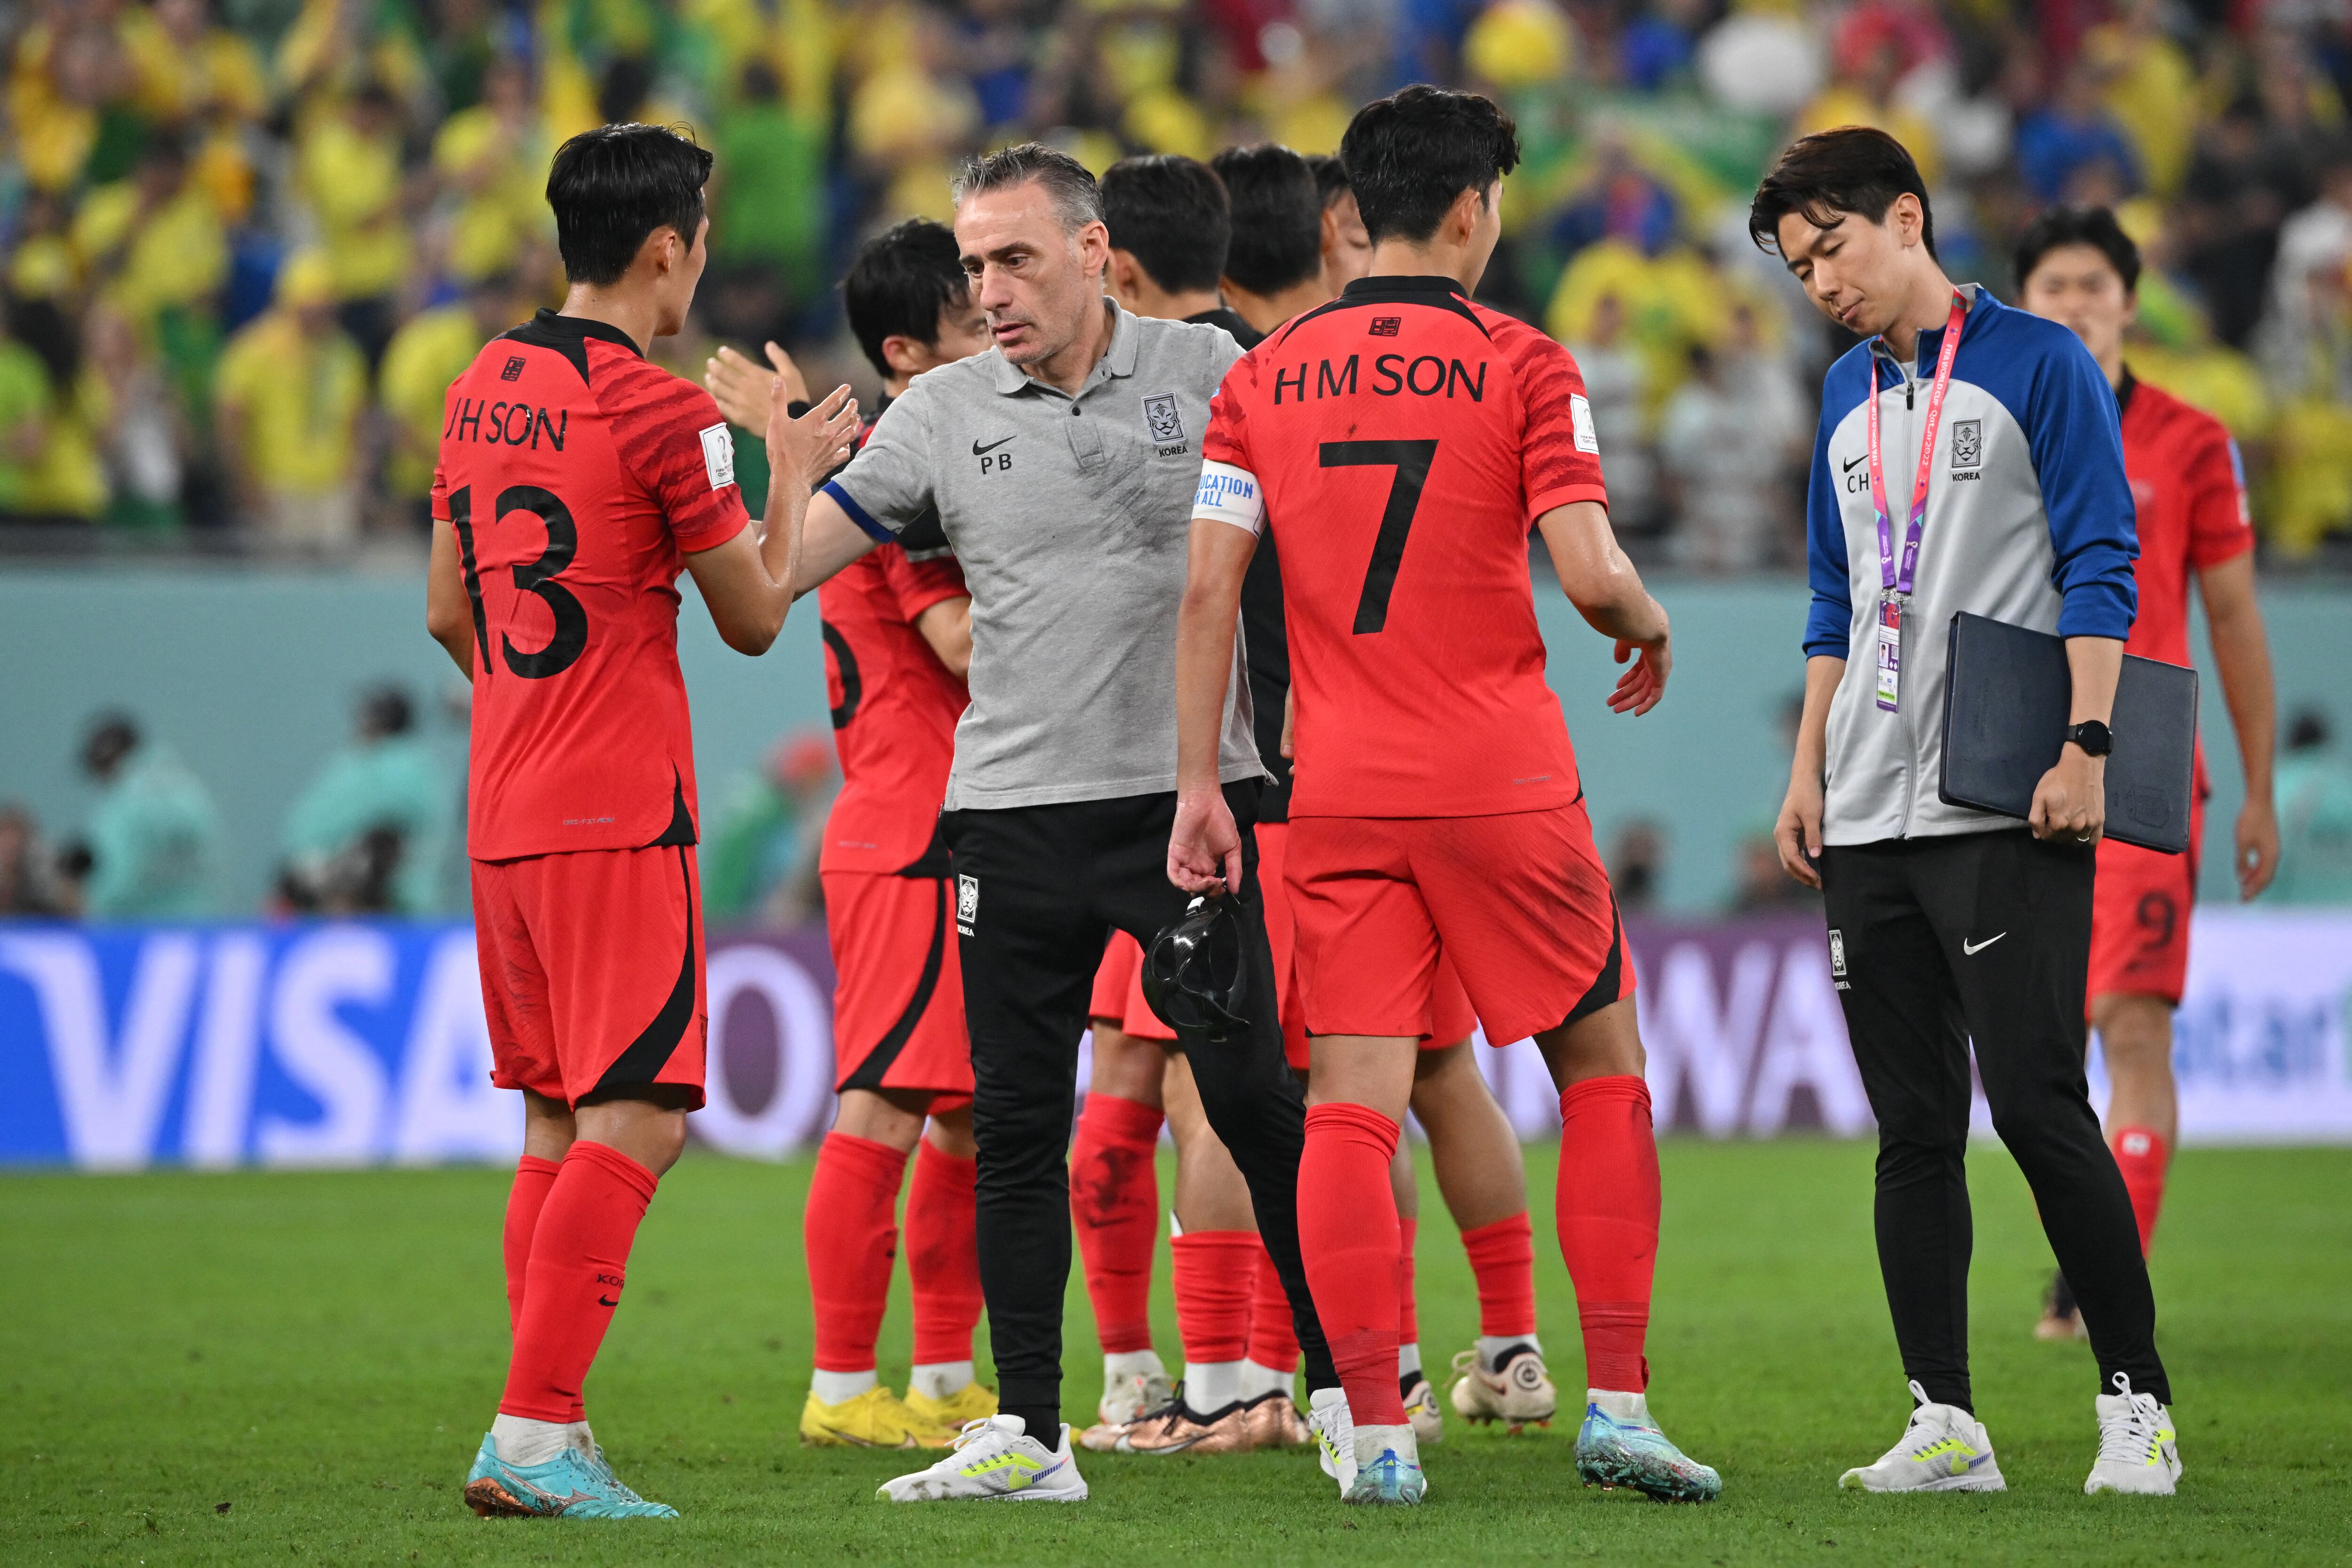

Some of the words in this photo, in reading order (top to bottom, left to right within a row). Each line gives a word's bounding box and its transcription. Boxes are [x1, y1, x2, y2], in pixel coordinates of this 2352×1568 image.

[1943, 344, 1953, 360] FIFA
[1372, 354, 1487, 402] SON
[1936, 361, 1948, 390] WORLD
[1933, 390, 1941, 406] CUP
[485, 401, 567, 451] SON
[1159, 446, 1188, 457] KOREA
[1199, 474, 1253, 499] UCATION
[1952, 471, 1980, 482] KOREA
[1201, 491, 1222, 507] ALL
[1319, 439, 1439, 635] 7
[449, 485, 588, 679] 13
[2137, 890, 2176, 952] 9
[1835, 981, 1851, 990] OREA
[0, 929, 526, 1170] VISA
[597, 1274, 625, 1289] KOR
